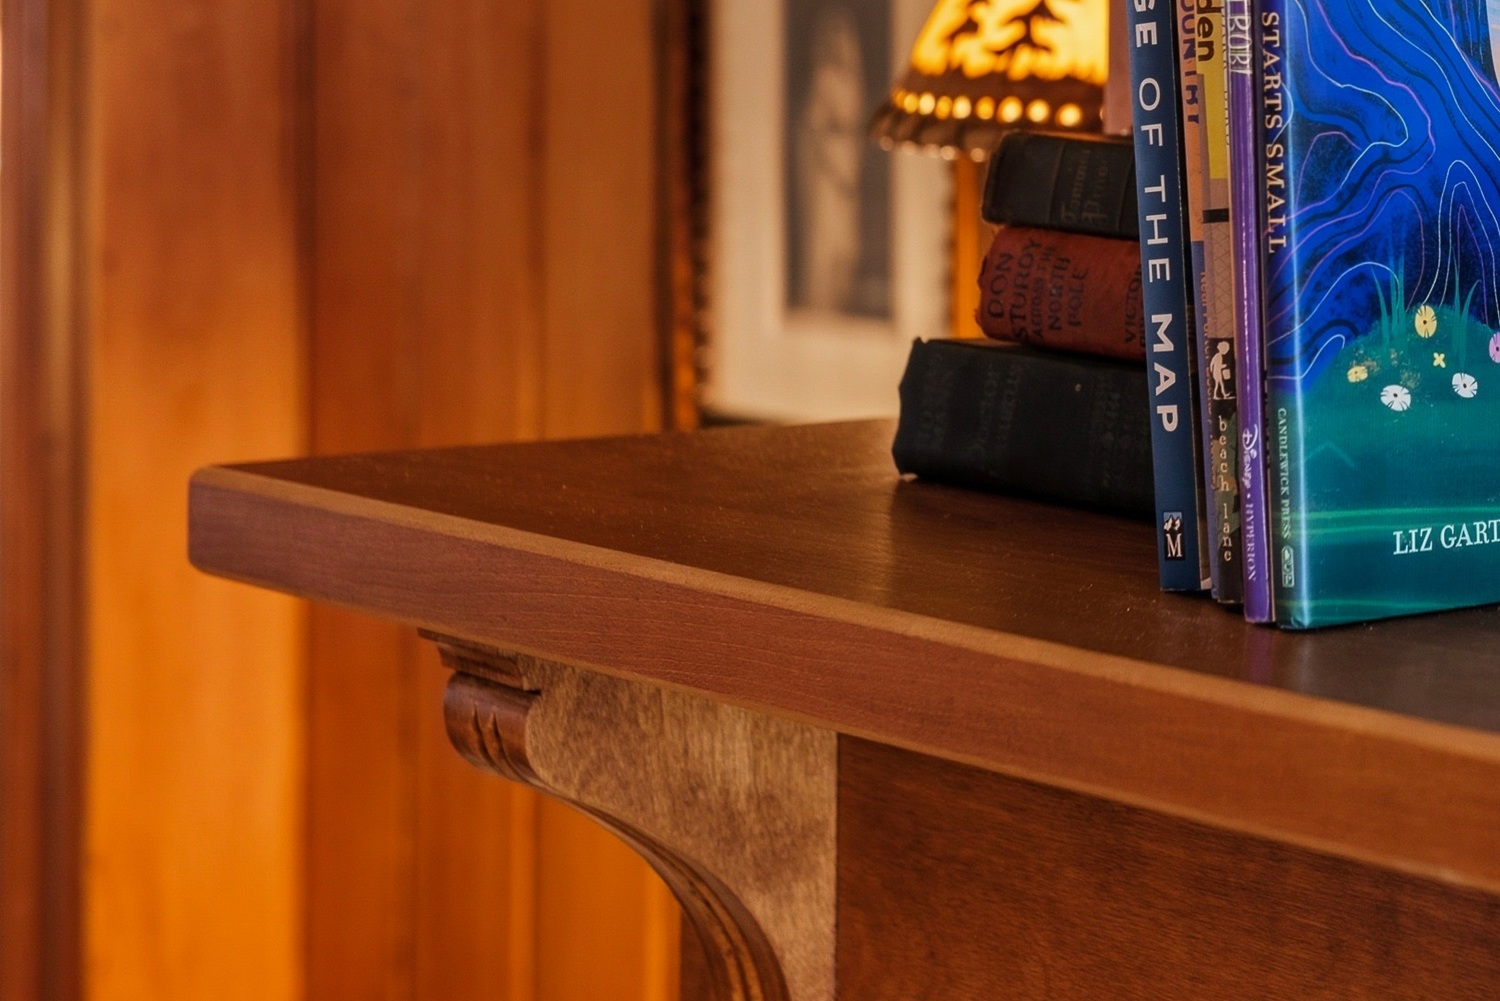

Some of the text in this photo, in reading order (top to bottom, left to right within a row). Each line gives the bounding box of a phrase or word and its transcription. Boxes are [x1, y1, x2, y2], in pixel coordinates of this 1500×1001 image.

[1138, 77, 1164, 147] OF
[1261, 11, 1283, 130] STARTS
[1143, 173, 1171, 284] THE
[1266, 144, 1288, 254] SMALL
[988, 253, 1013, 319] DON
[1150, 313, 1179, 434] MAP
[1218, 415, 1233, 562] beach lane
[1278, 407, 1291, 539] CANDLEWICK PRESS
[1165, 533, 1183, 558] M
[1392, 527, 1433, 555] LIZ
